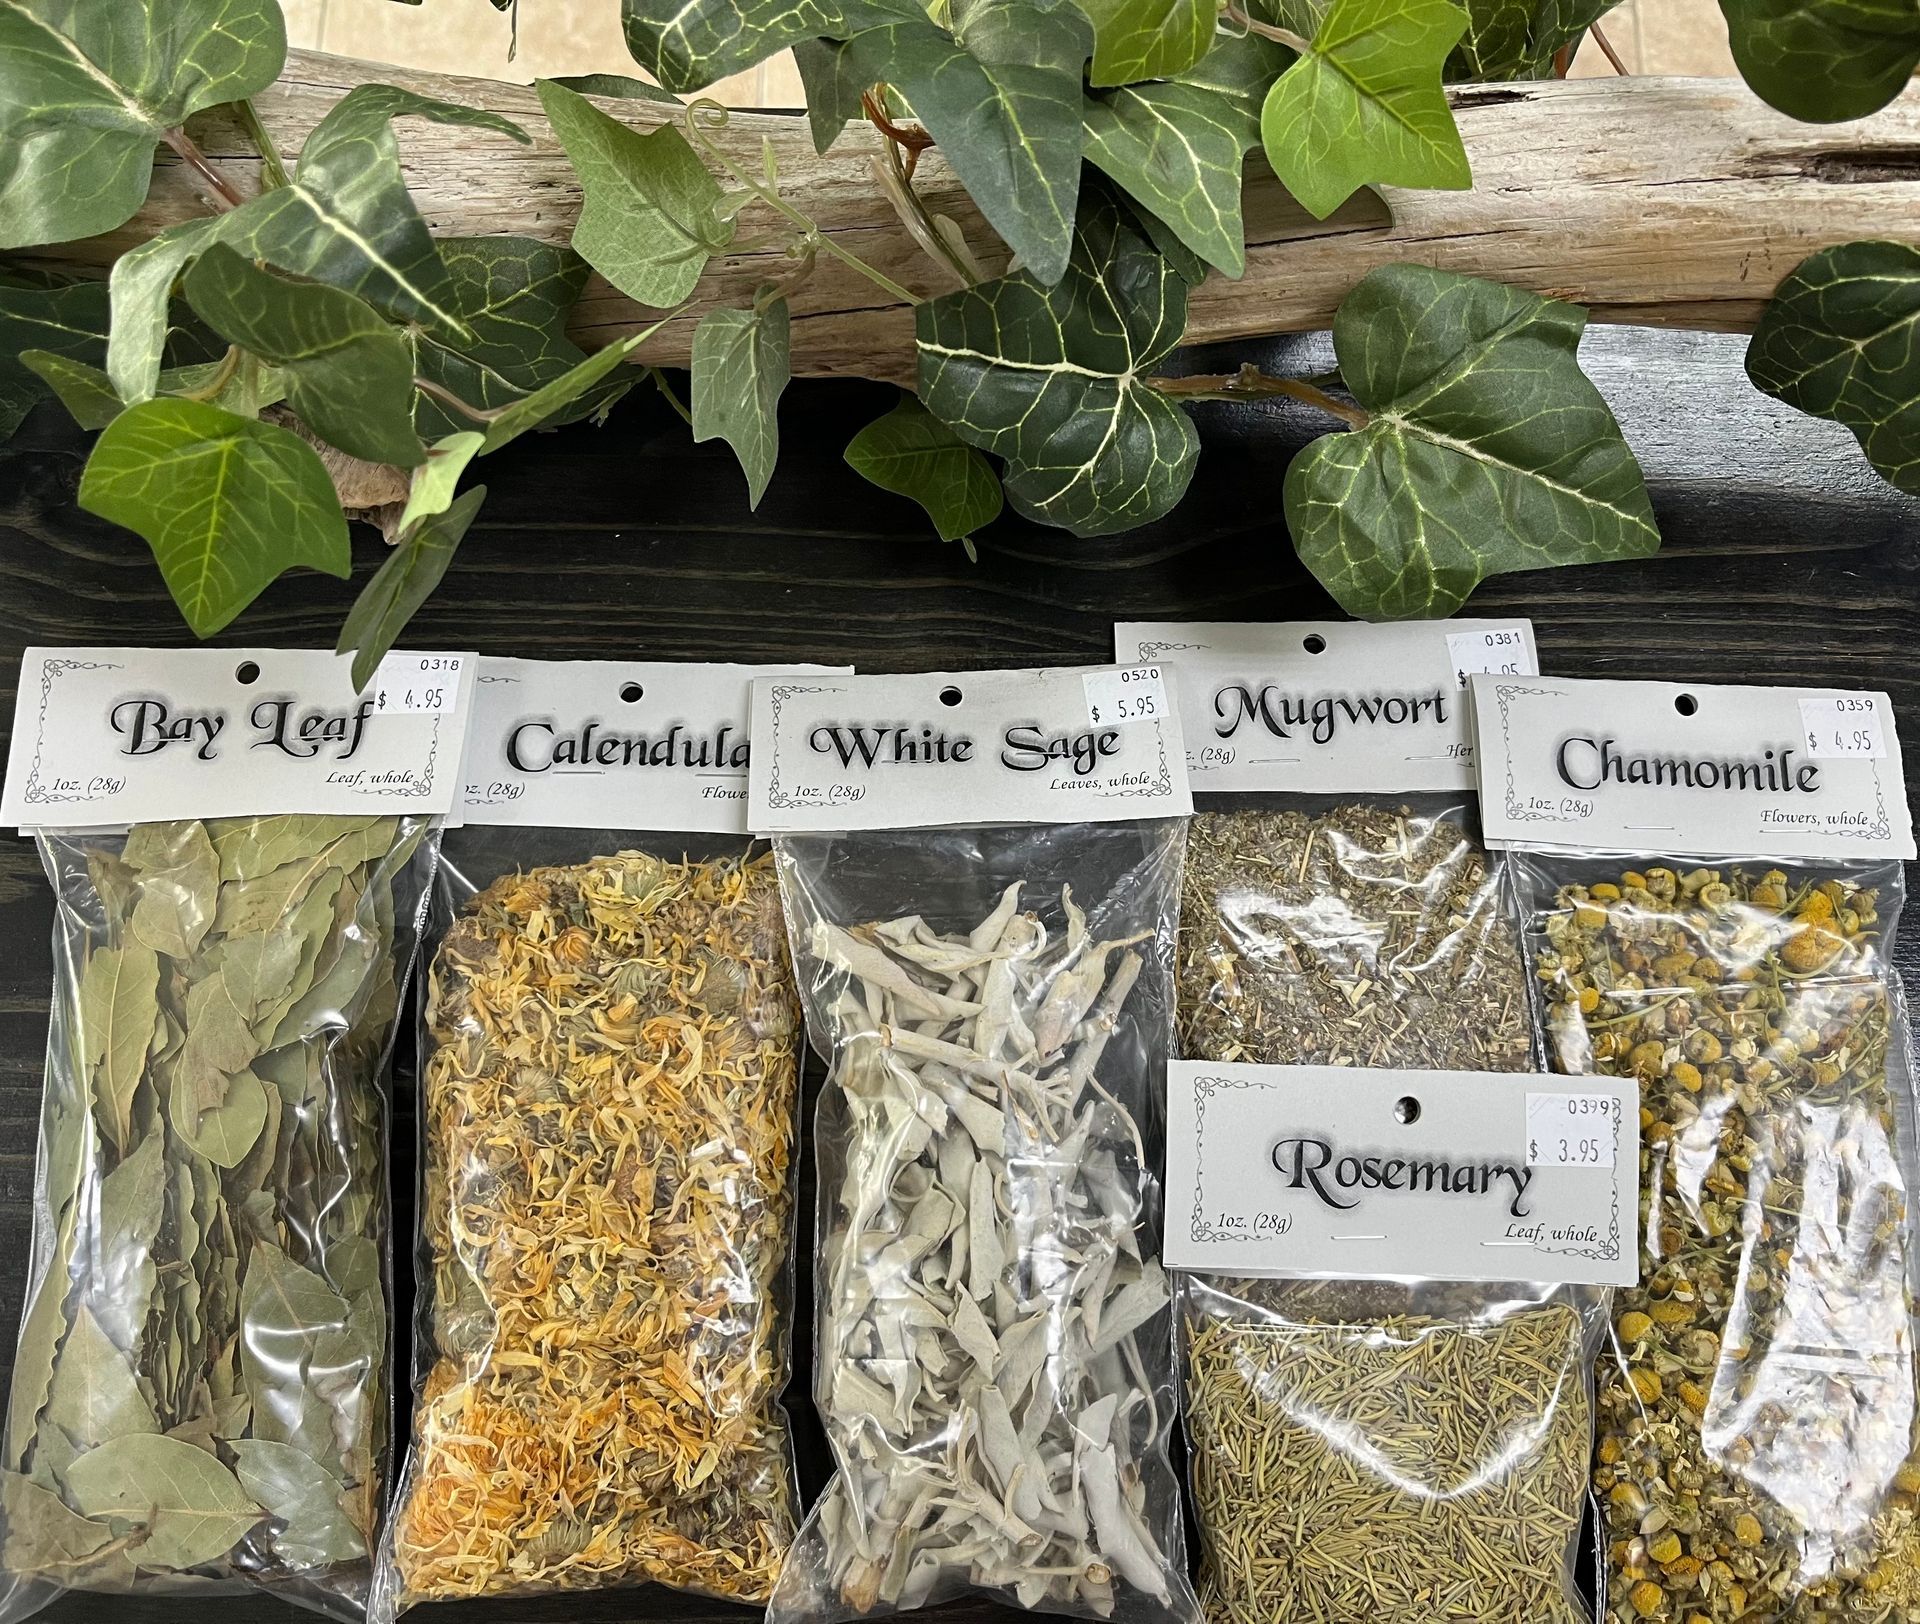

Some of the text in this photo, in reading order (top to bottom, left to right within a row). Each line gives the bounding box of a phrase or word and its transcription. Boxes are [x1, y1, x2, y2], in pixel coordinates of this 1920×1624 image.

[1483, 631, 1522, 647] 0381
[419, 658, 460, 671] 0318
[1121, 668, 1159, 683] 0520
[1456, 667, 1468, 689] $
[377, 687, 444, 710] $ 4.95
[1836, 699, 1873, 712] 0359
[1091, 695, 1155, 724] $ 5.95
[1214, 685, 1449, 745] Mugwort
[108, 699, 373, 761] Bay Leaf
[1808, 730, 1871, 751] $ 4.95
[505, 722, 750, 774] Calendula
[808, 724, 1121, 776] White Sage
[1200, 745, 1236, 766] (28g)
[1555, 736, 1821, 794] Chamomile
[51, 775, 127, 795] 1oz. (28g)
[325, 770, 414, 786] Leaf, whole
[1049, 772, 1150, 792] Leaves, whole
[487, 781, 526, 800] (28g)
[701, 785, 748, 800] Flowe
[793, 783, 867, 801] 1oz. (28g)
[1527, 795, 1594, 818] 1oz. (28g)
[1760, 809, 1869, 827] Flowers, whole
[1568, 1098, 1609, 1115] 0399
[1528, 1138, 1599, 1163] $ 3.95
[1271, 1138, 1532, 1218] Rosemary
[1216, 1211, 1293, 1233] 1oz. (28g)
[1503, 1222, 1598, 1243] Leaf, whole
